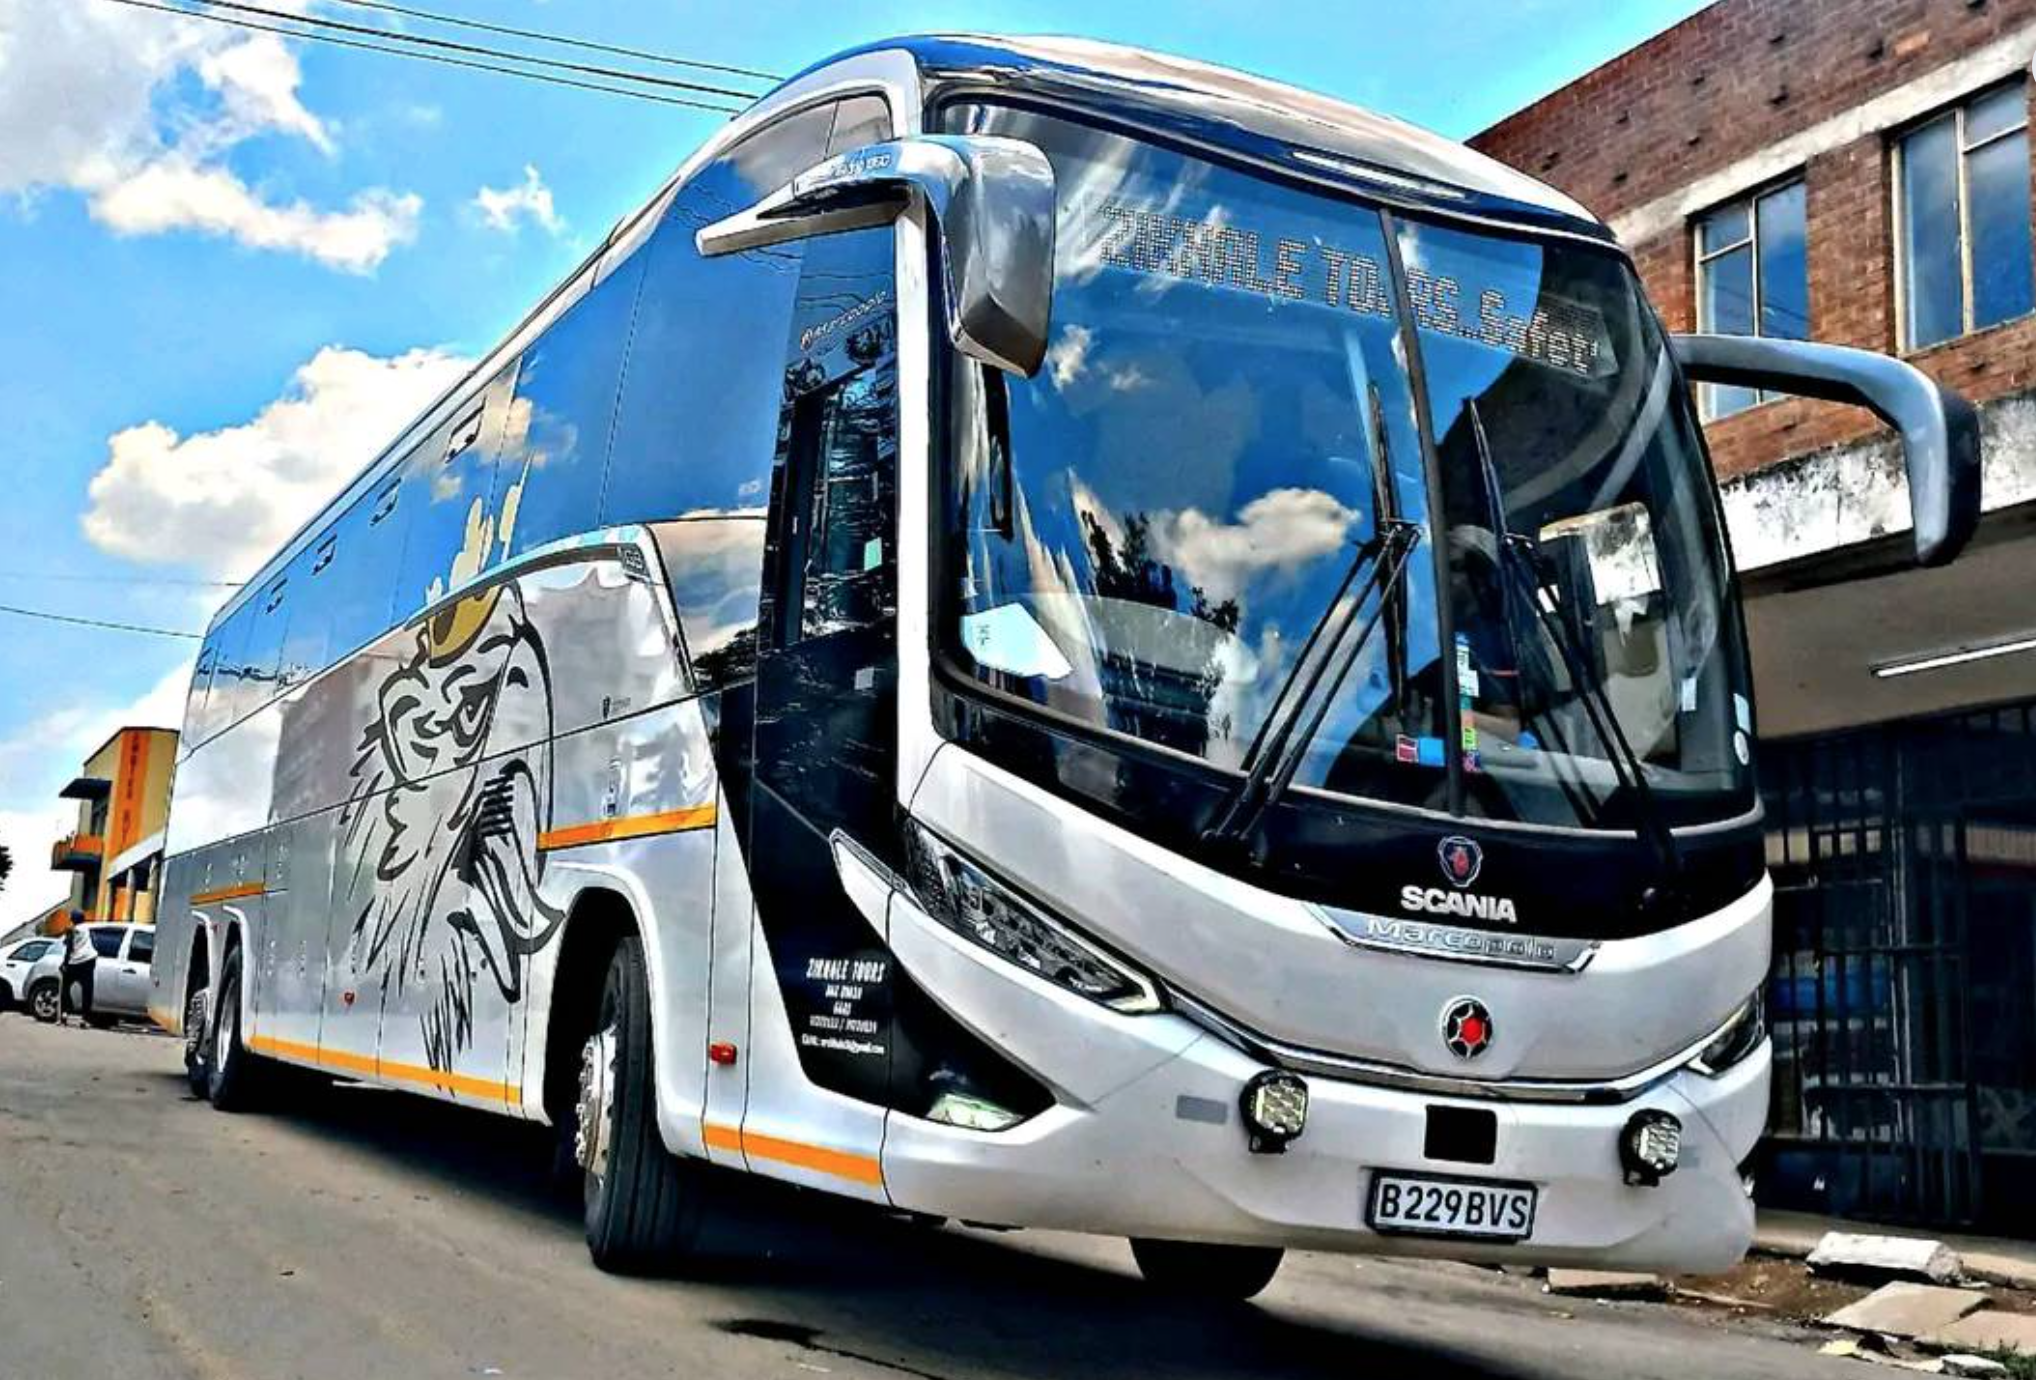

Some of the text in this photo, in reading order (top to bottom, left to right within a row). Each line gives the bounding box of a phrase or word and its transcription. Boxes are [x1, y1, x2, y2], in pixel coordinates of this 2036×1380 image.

[1401, 885, 1517, 923] SCANIA
[1366, 918, 1556, 959] Marcopolo
[1380, 1184, 1528, 1229] B229BVS
